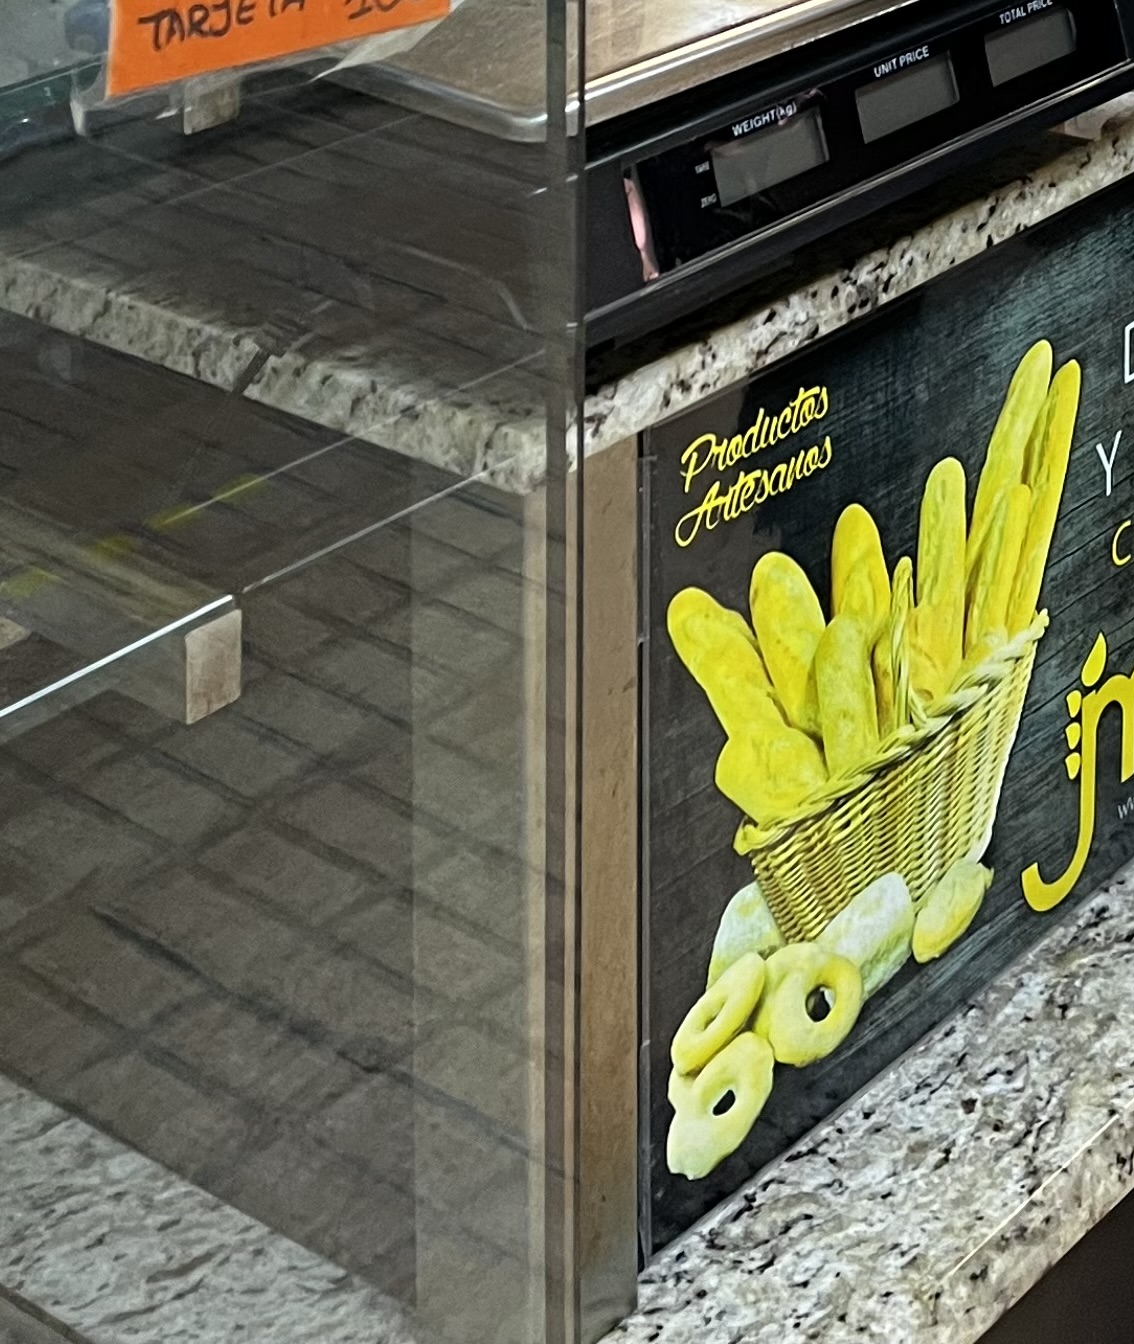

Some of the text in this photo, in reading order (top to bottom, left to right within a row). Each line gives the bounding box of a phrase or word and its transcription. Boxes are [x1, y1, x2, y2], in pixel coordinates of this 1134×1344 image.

[1000, 9, 1026, 25] TOTAL
[873, 45, 929, 78] UNIT PRICE
[680, 385, 829, 494] Productos
[1096, 430, 1123, 497] Y
[675, 436, 832, 547] Artesanos
